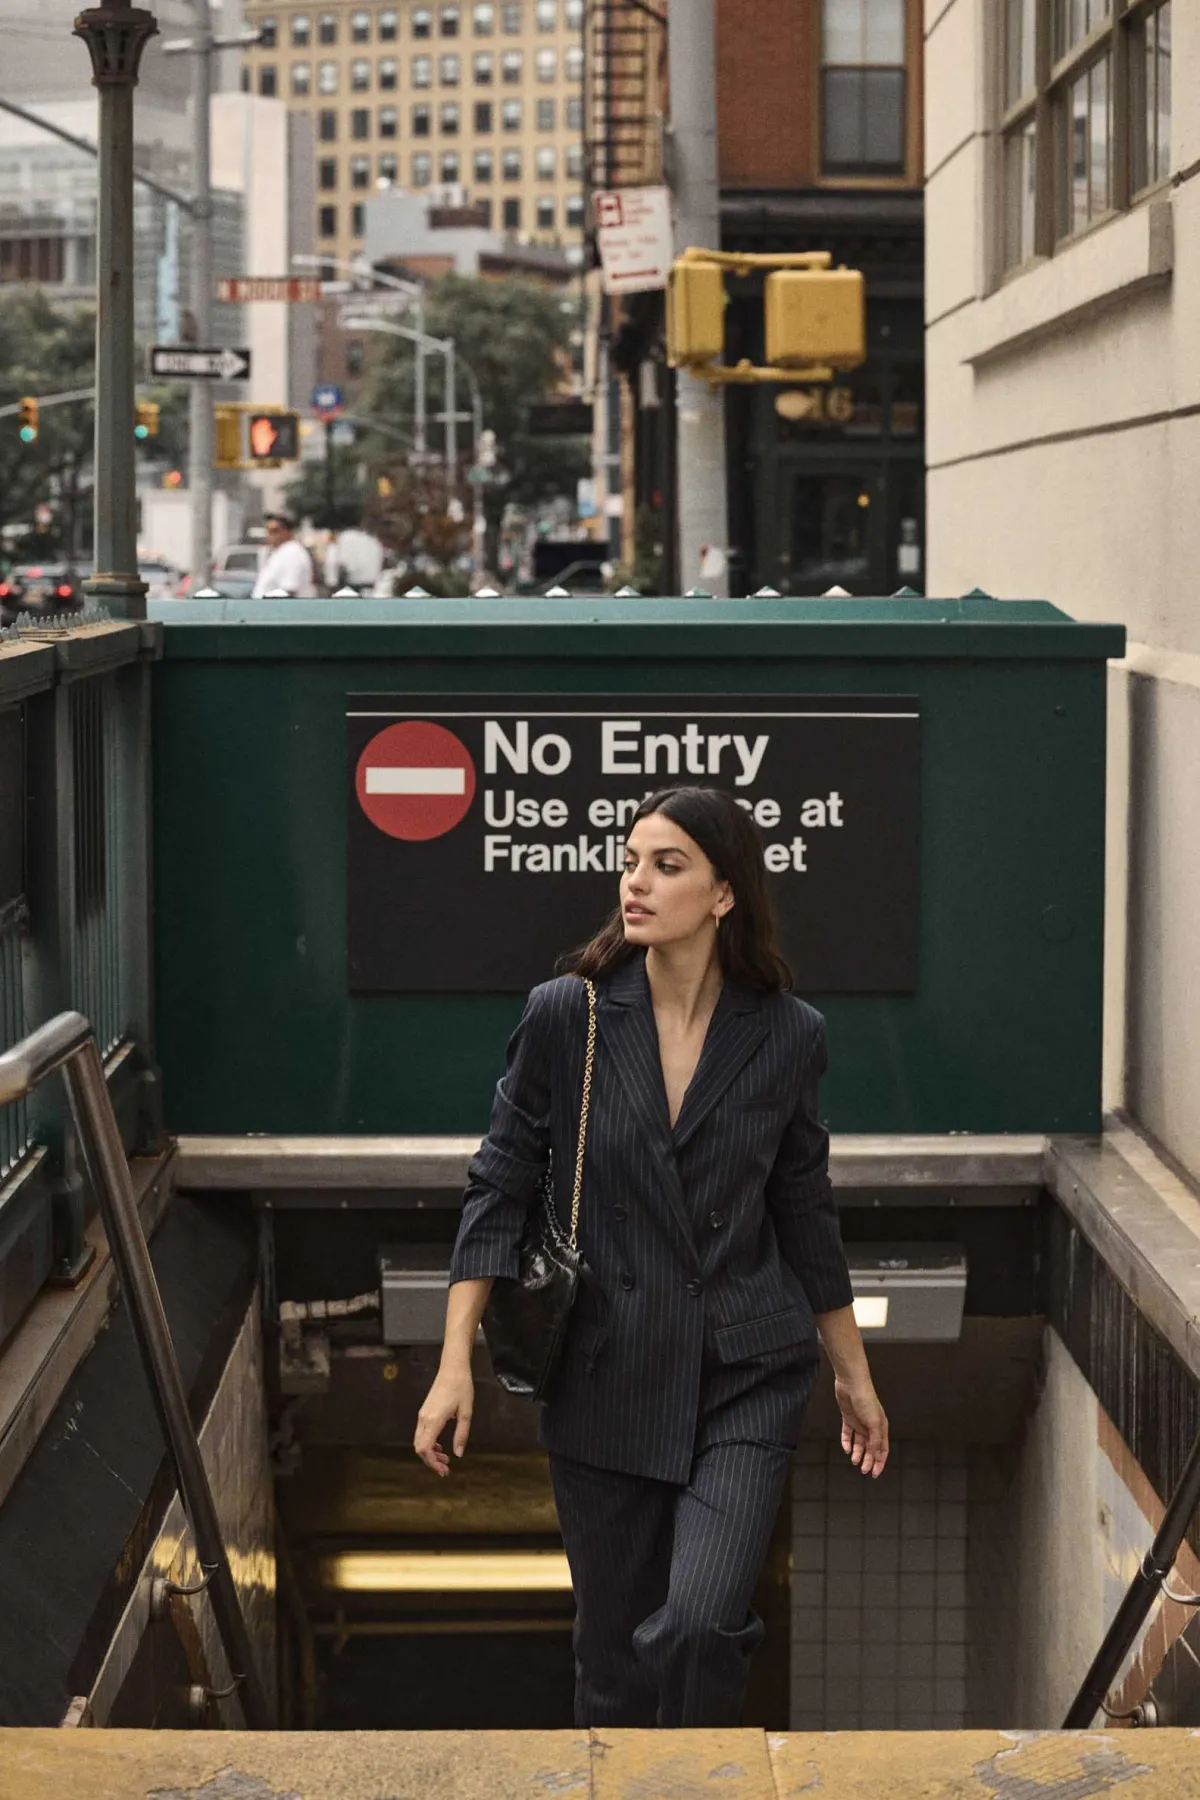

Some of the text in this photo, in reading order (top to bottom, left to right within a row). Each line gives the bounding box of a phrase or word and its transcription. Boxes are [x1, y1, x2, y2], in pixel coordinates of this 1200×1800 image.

[484, 721, 769, 786] No Entry
[484, 790, 569, 828] Use
[800, 791, 844, 828] at
[484, 835, 625, 872] Frankli
